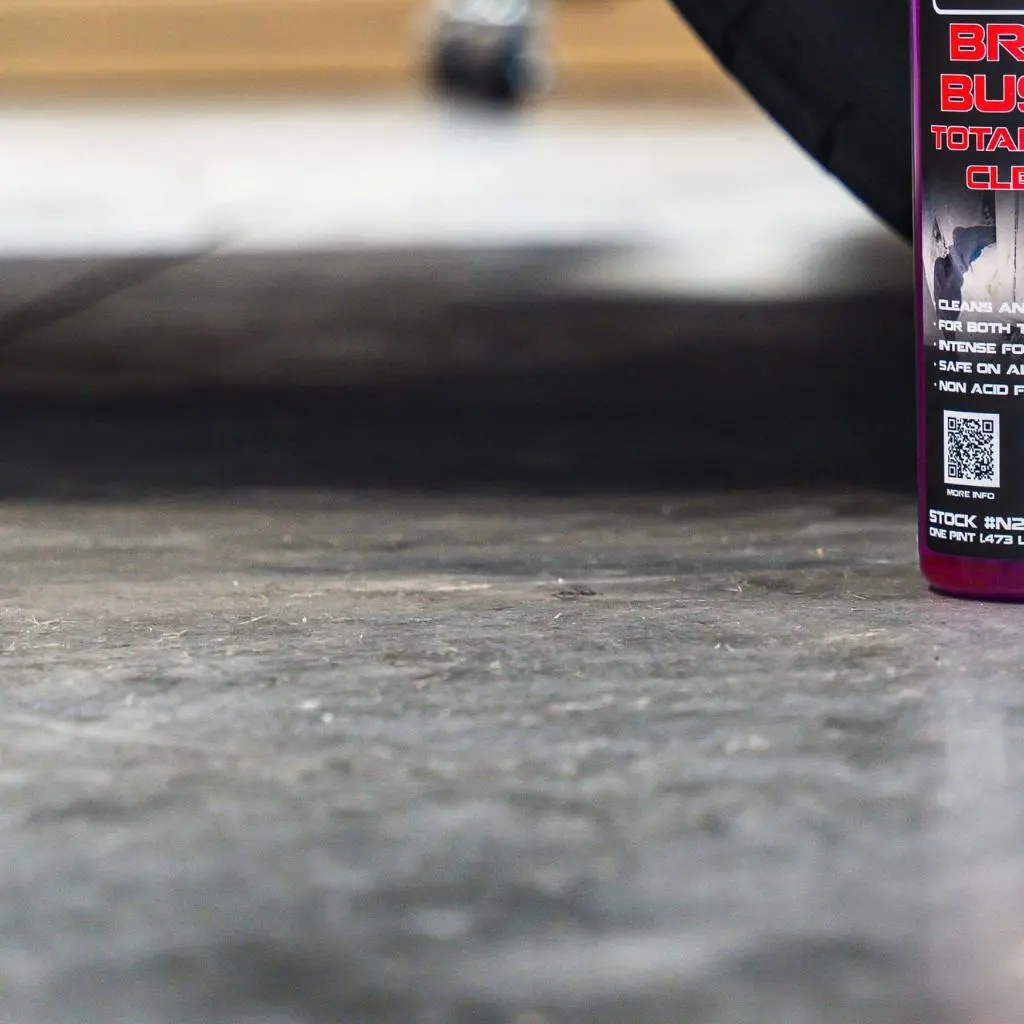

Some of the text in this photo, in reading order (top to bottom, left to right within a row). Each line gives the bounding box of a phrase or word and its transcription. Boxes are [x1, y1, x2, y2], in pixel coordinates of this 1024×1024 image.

[938, 298, 993, 313] CLEANS
[938, 319, 963, 333] FOR
[966, 321, 1011, 334] BOTH
[938, 339, 997, 354] INTENSE
[938, 360, 973, 374] SAFE
[976, 363, 1001, 375] ON
[938, 380, 967, 394] NON
[970, 383, 1009, 396] ACID
[946, 488, 995, 500] MORE INFO
[929, 508, 978, 529] STOCK
[929, 526, 947, 539] ONE
[949, 531, 976, 543] PINT
